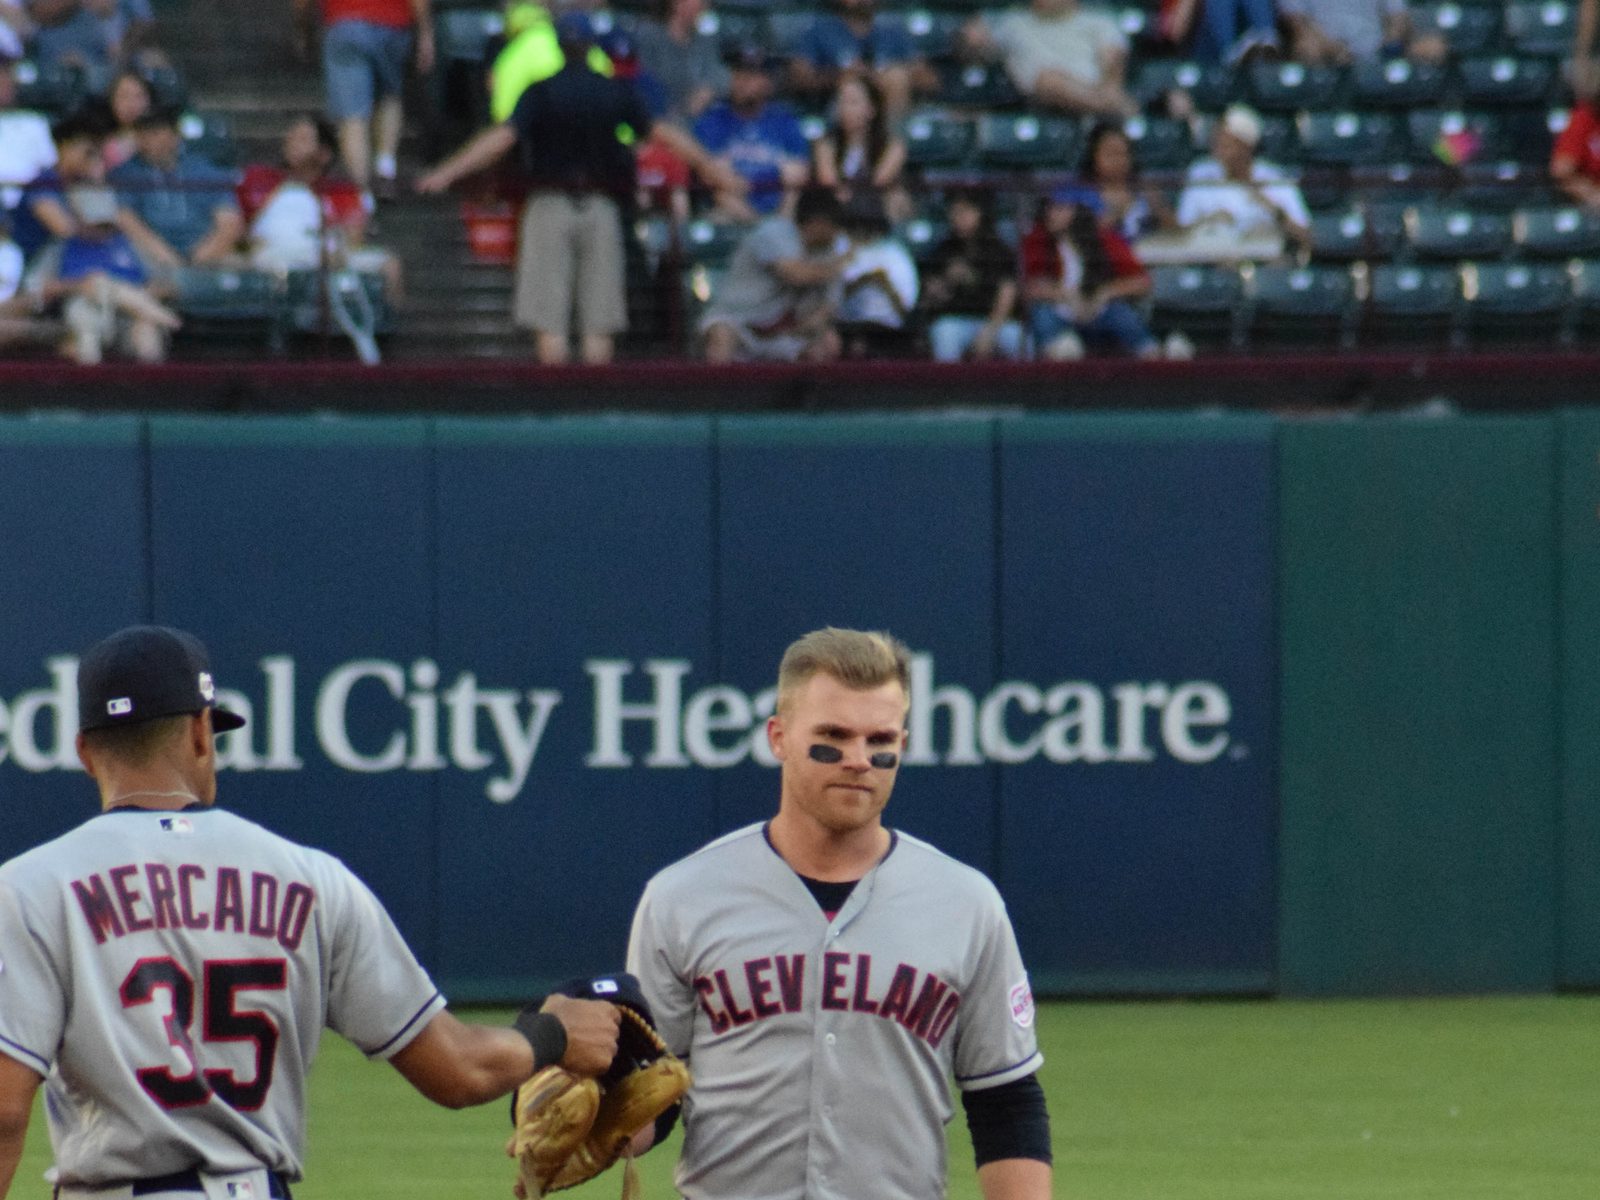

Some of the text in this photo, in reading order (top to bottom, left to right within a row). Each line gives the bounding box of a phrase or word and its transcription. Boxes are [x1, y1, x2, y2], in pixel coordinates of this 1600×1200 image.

[0, 652, 1231, 803] dal City Hehcare
[71, 863, 315, 951] MERCADO
[119, 956, 287, 1112] 35
[692, 951, 961, 1050] CLEVELAND
